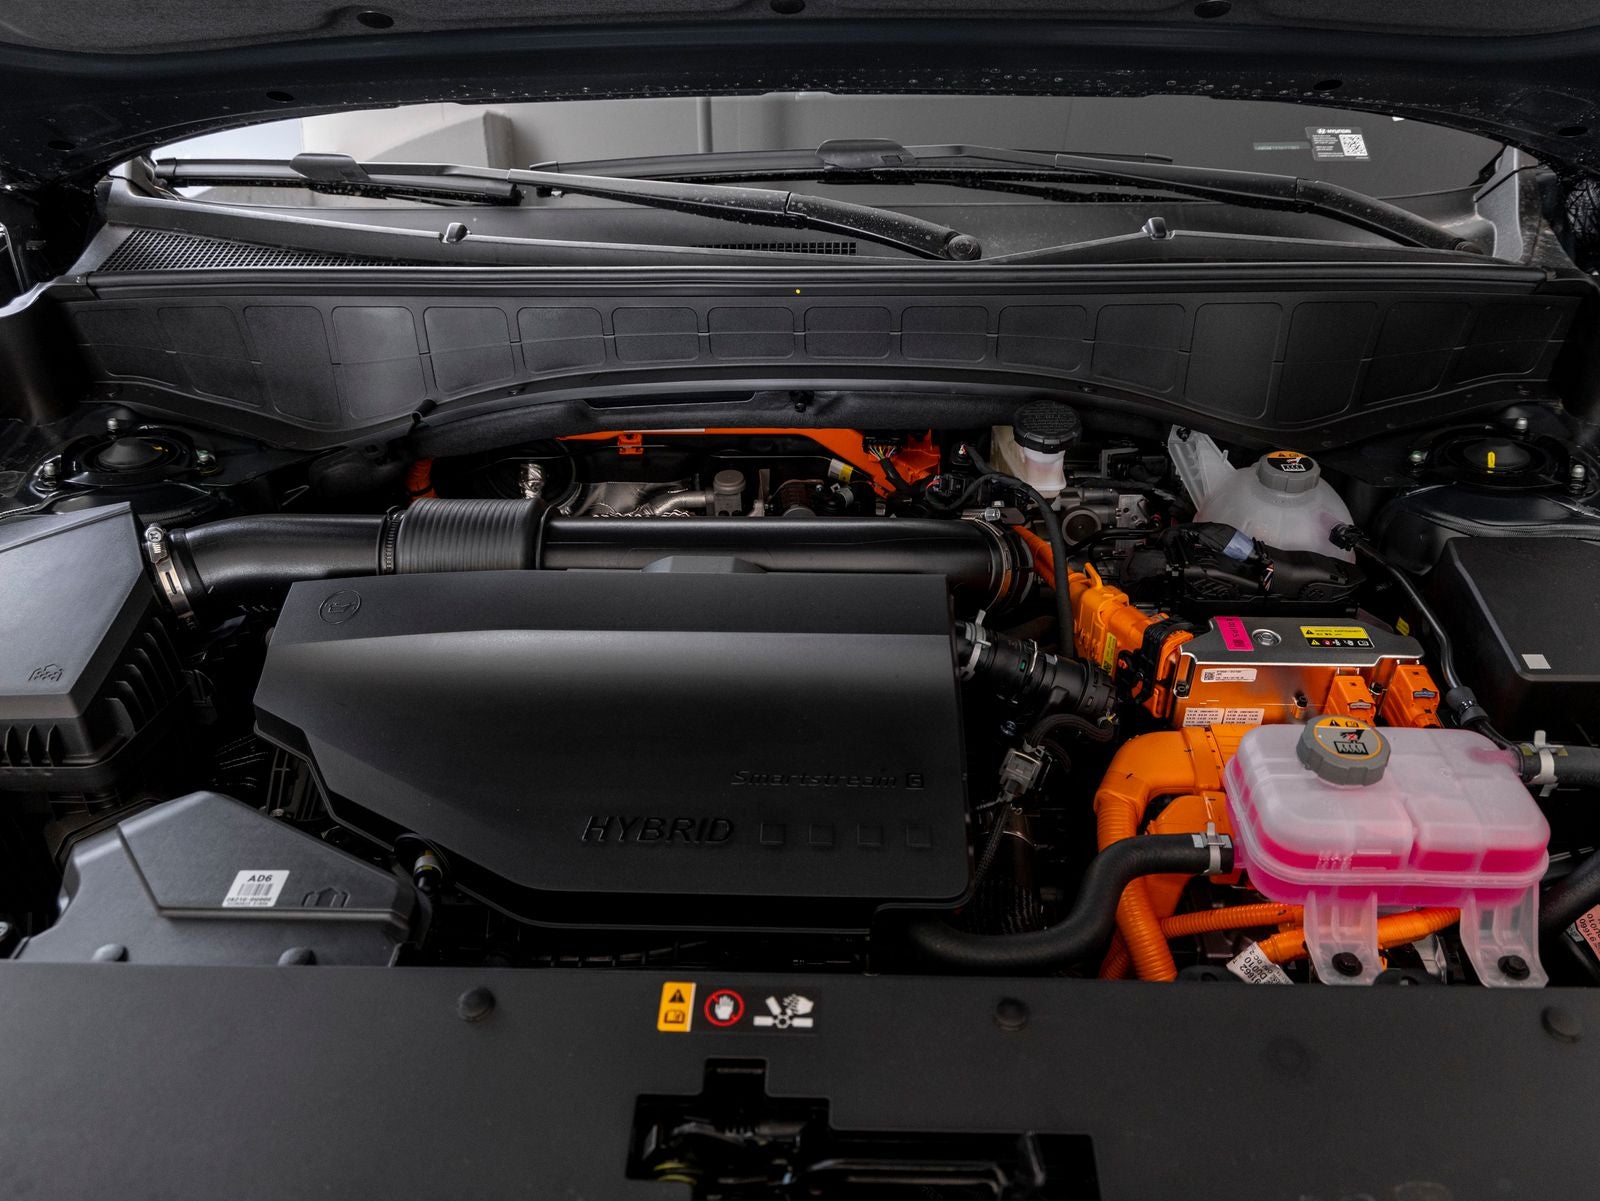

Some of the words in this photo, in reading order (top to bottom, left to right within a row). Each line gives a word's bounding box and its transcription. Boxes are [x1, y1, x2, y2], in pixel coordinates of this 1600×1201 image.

[731, 770, 897, 789] Smartstream
[581, 815, 734, 843] HYBRID
[247, 874, 273, 882] AD6
